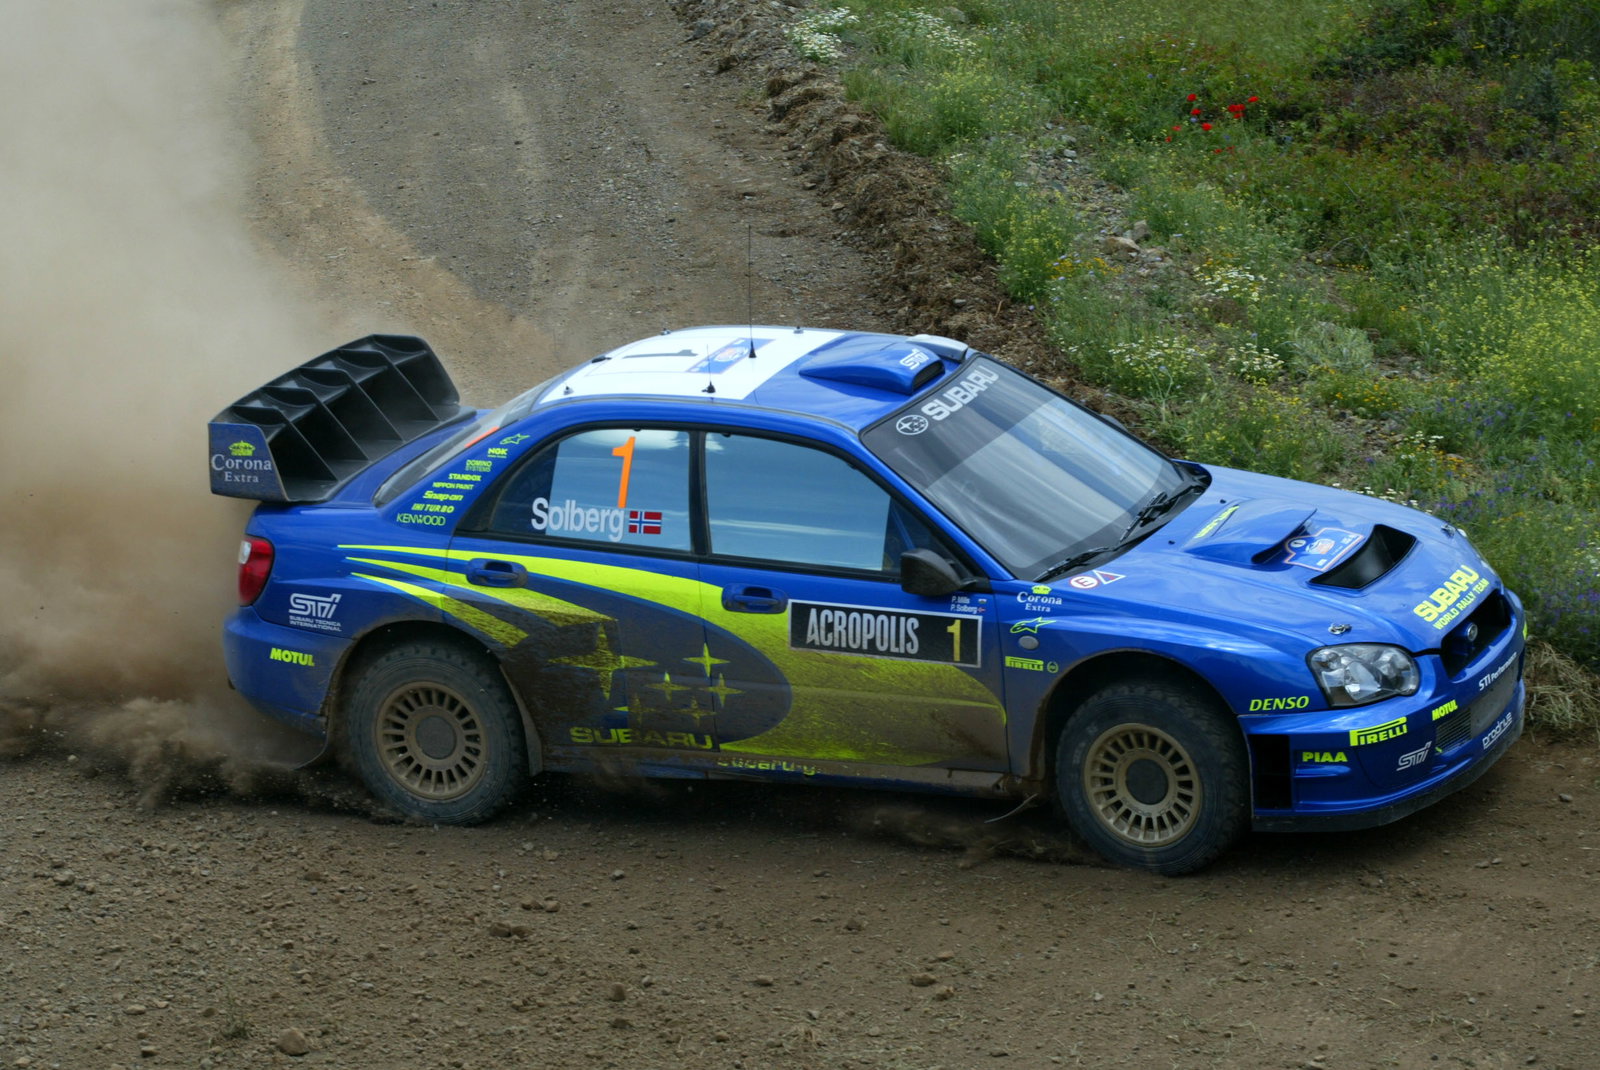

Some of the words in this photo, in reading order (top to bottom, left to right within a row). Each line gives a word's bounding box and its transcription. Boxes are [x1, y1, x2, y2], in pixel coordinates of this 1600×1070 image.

[921, 365, 1000, 421] SUBARU
[488, 447, 508, 455] NGK
[211, 453, 273, 471] Corona
[224, 471, 259, 483] Extra
[448, 473, 482, 481] STANDOX
[612, 436, 636, 509] 1
[423, 490, 464, 501] Snap-on
[424, 503, 455, 513] TURBO
[396, 513, 446, 526] KENWOOD
[531, 497, 625, 542] Solberg
[1016, 591, 1062, 605] Corona
[1413, 565, 1479, 622] SUBARU
[1025, 603, 1051, 612] Extra
[1432, 608, 1460, 630] WORLD
[1456, 591, 1477, 611] RALLY
[1473, 578, 1490, 594] TEAM
[806, 607, 920, 655] ACROPOLIS
[947, 619, 962, 662] 1
[270, 647, 315, 667] MOTUL
[1249, 696, 1309, 712] DENSO
[1432, 699, 1458, 721] MOTUL
[1349, 716, 1408, 747] PIRELLI
[1302, 752, 1348, 763] PIAA
